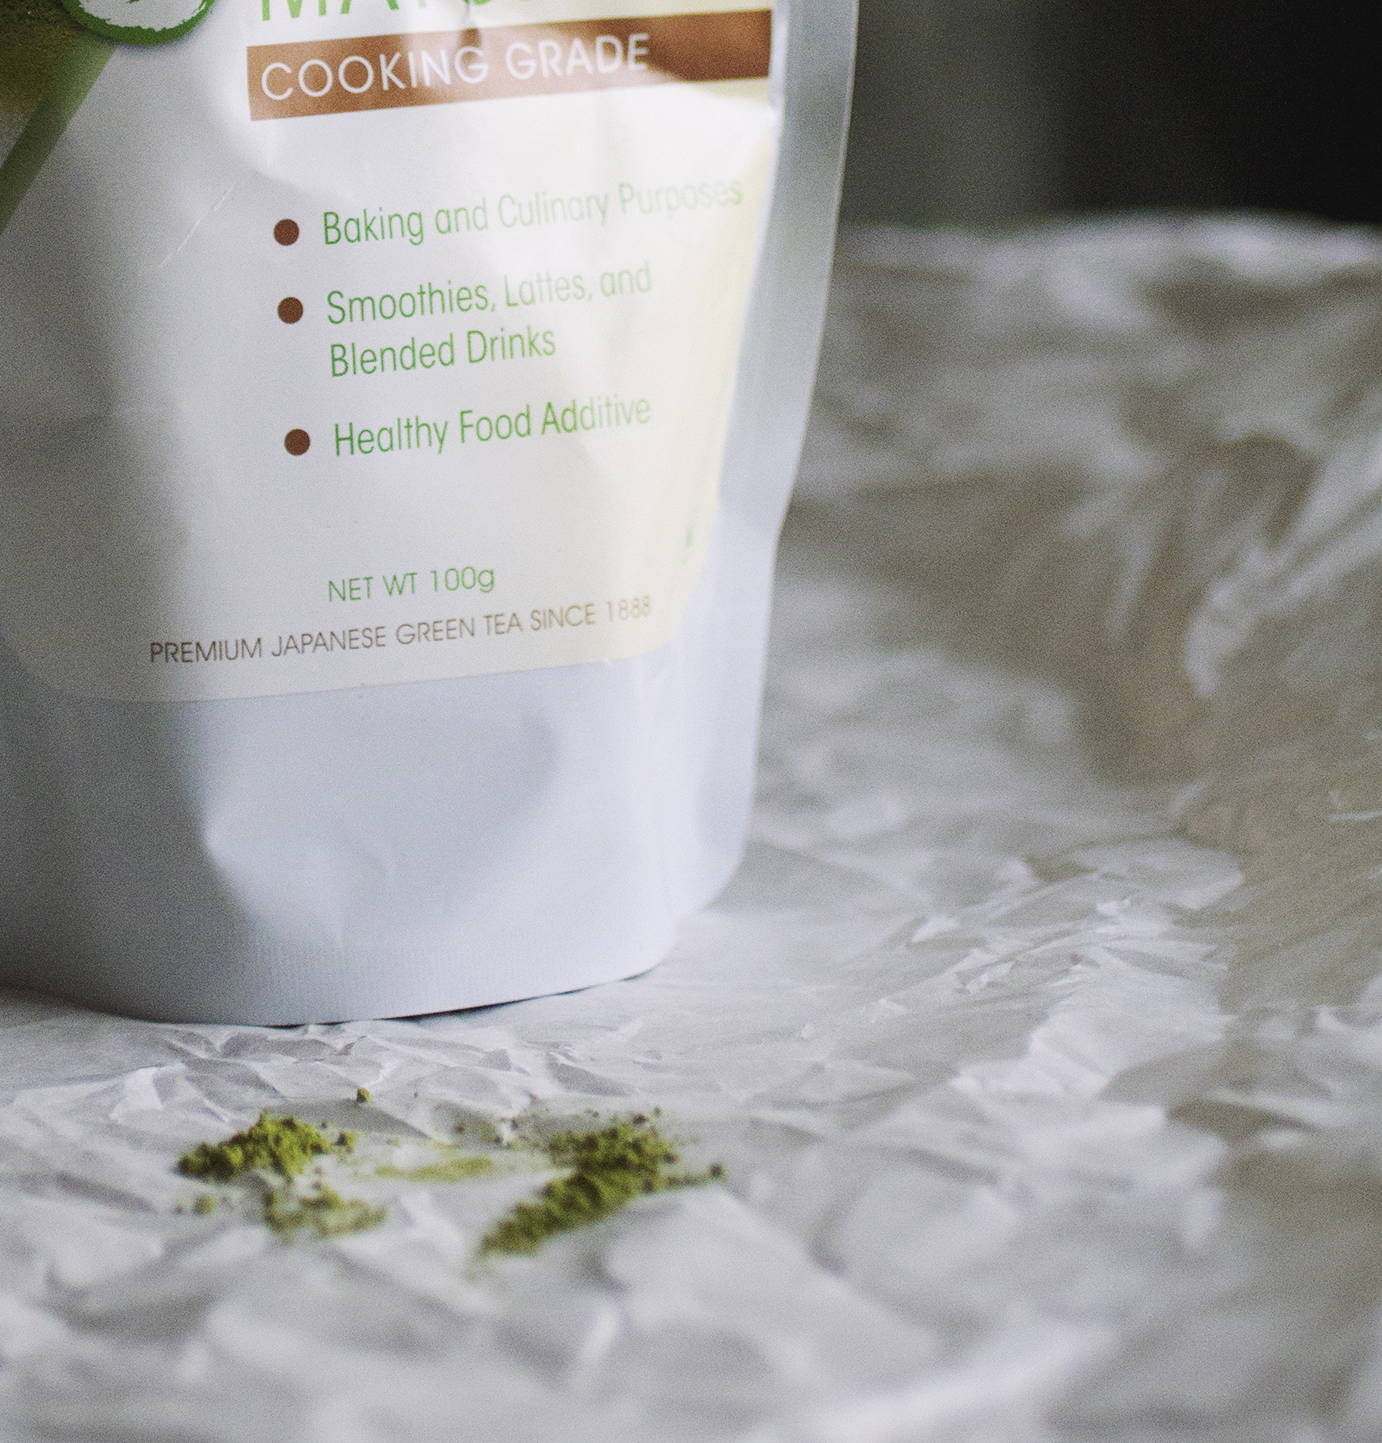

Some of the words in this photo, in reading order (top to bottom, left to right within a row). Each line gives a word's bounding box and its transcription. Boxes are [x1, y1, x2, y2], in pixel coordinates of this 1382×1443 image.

[261, 42, 489, 102] COOKING
[506, 32, 650, 81] GRADE
[323, 207, 425, 246] Baking
[435, 198, 488, 236] and
[498, 188, 610, 228] Culinary
[618, 178, 743, 216] Purposes
[327, 281, 497, 325] Smoothies,
[504, 268, 595, 308] Lattes,
[600, 260, 652, 296] and
[330, 334, 455, 378] Blended
[467, 324, 557, 364] Drinks
[334, 416, 450, 456] Healthy
[459, 405, 532, 444] Food
[541, 394, 652, 436] Additive
[328, 577, 374, 603] NET
[383, 572, 418, 597] WT
[431, 566, 496, 594] 100g
[149, 637, 263, 664] PREMIUM
[271, 627, 387, 657] JAPANESE
[395, 618, 475, 646] GREEN
[483, 612, 523, 635] TEA
[530, 604, 596, 631] SINCE
